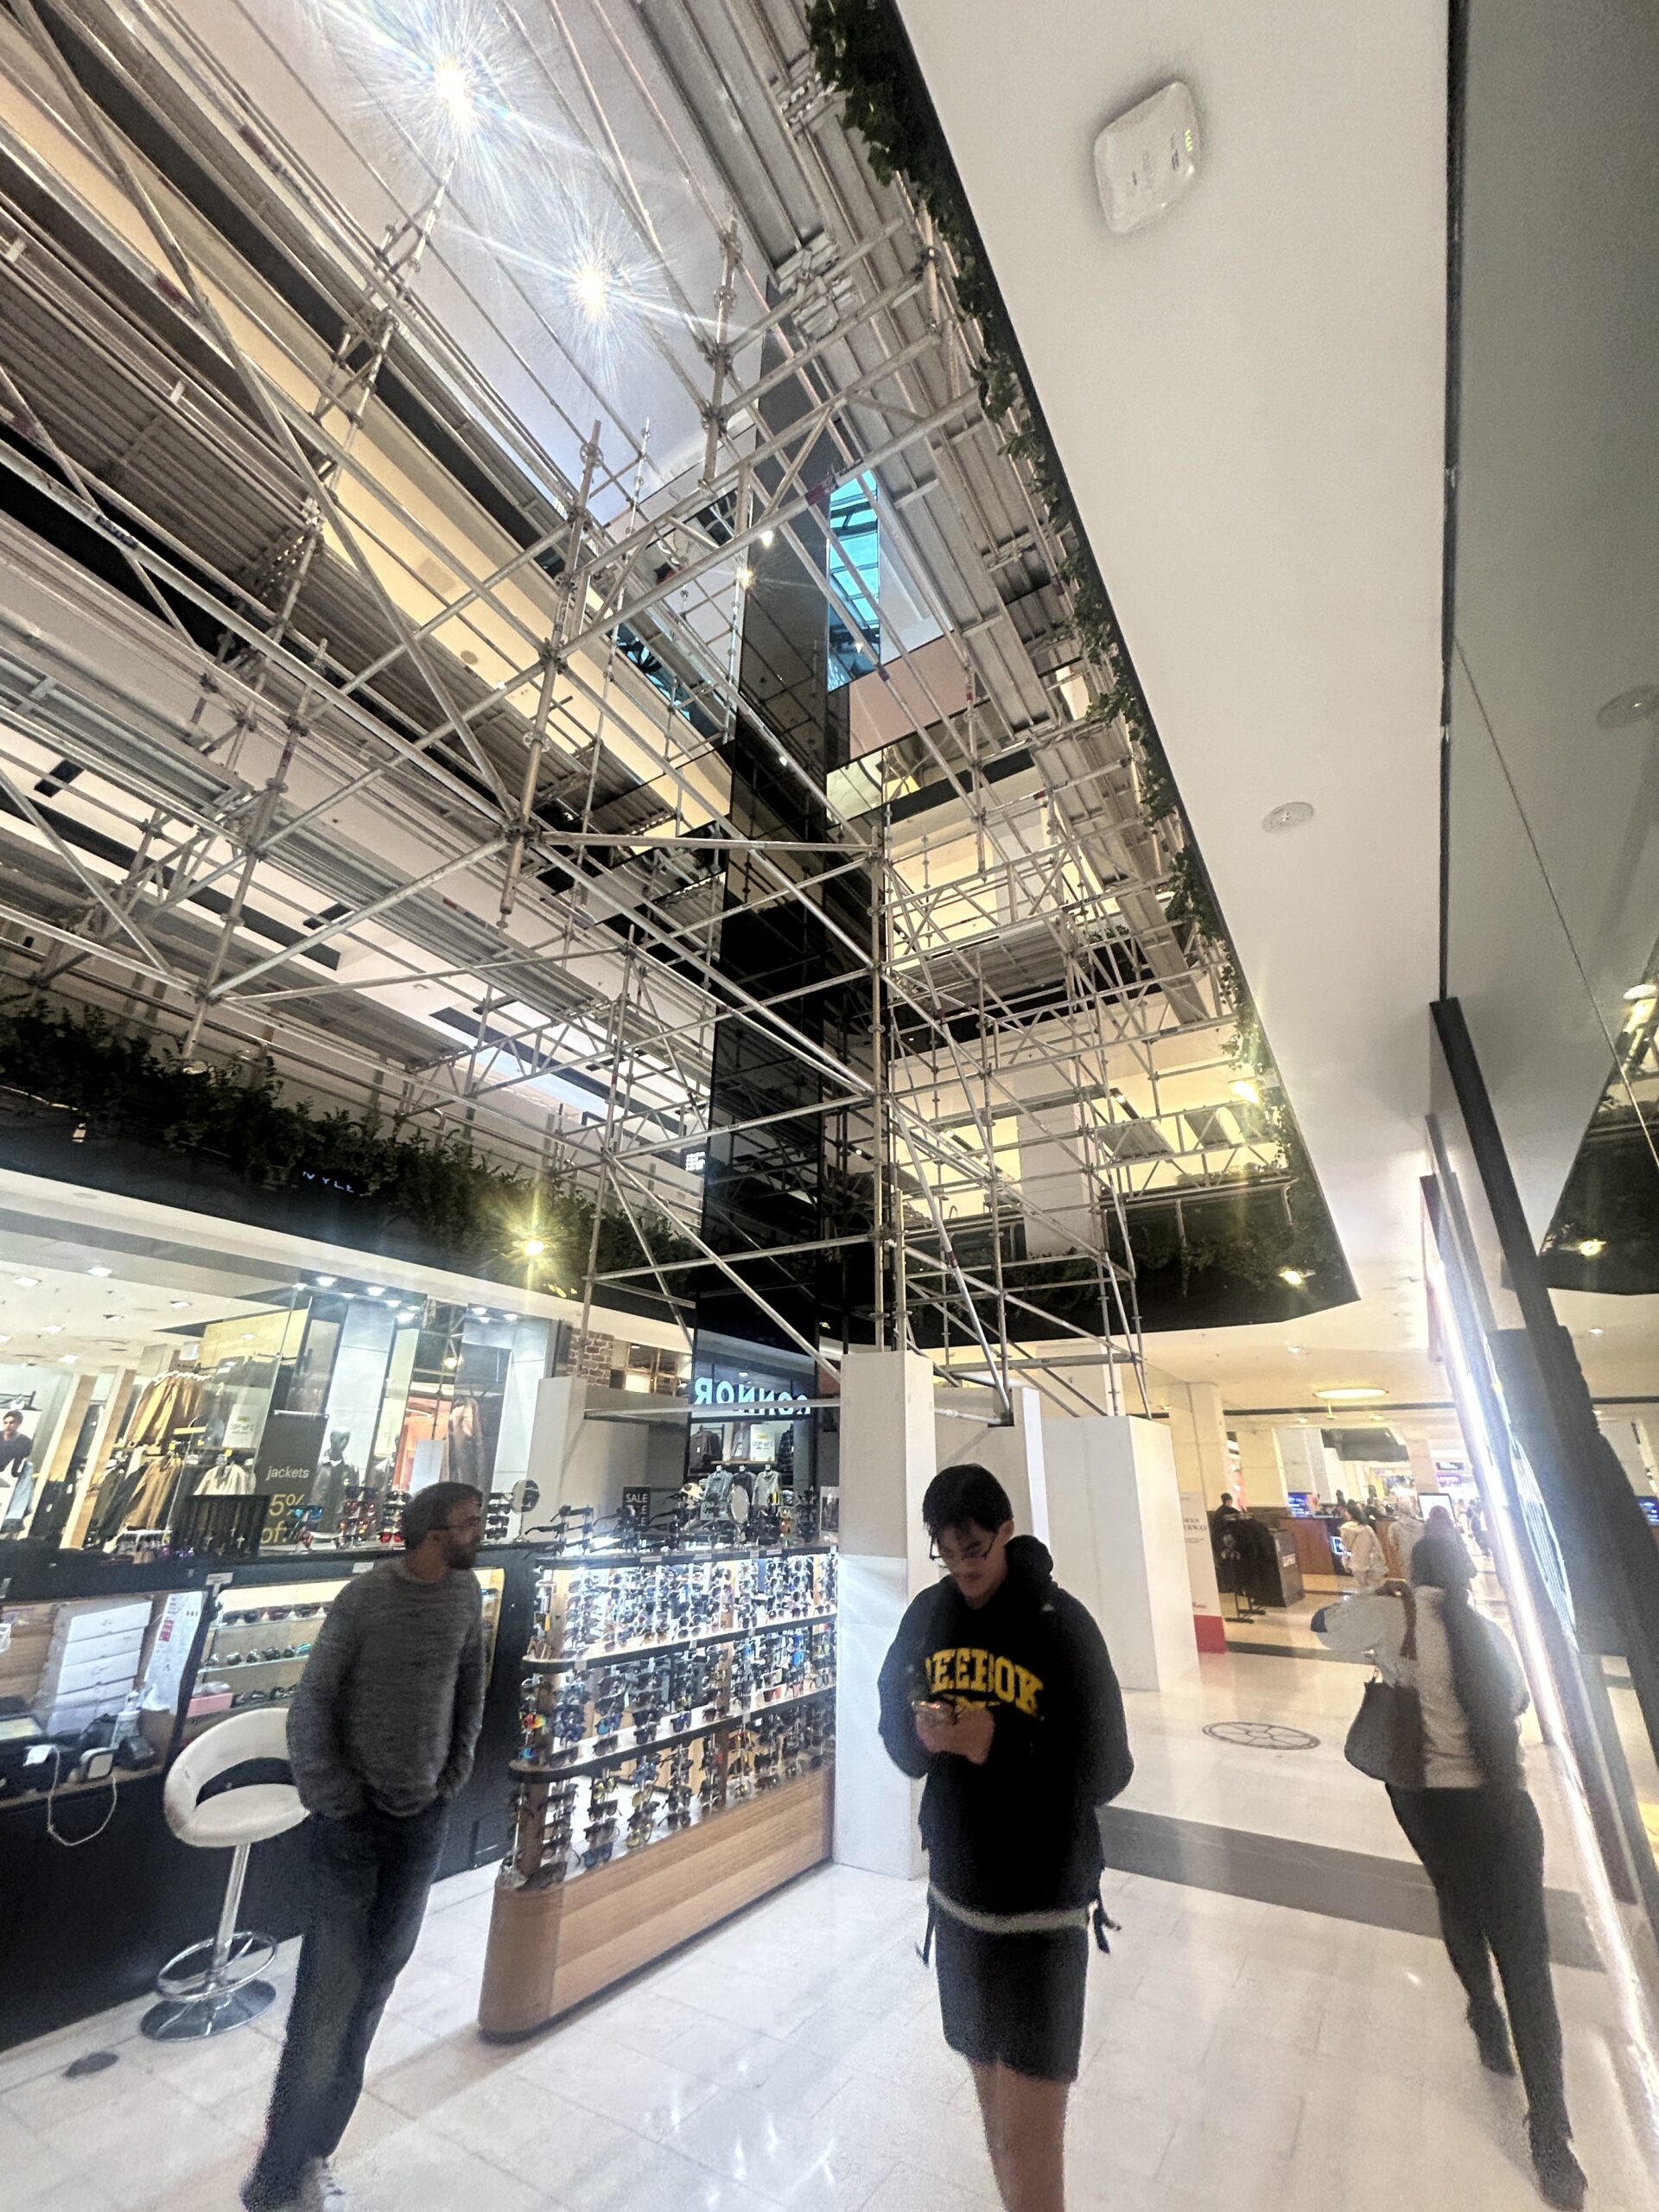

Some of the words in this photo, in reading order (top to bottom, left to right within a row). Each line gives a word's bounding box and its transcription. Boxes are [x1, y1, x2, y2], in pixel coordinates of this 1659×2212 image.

[265, 1466, 310, 1481] jackets
[626, 1493, 648, 1503] SALE
[925, 1647, 1044, 1719] EEBOK
